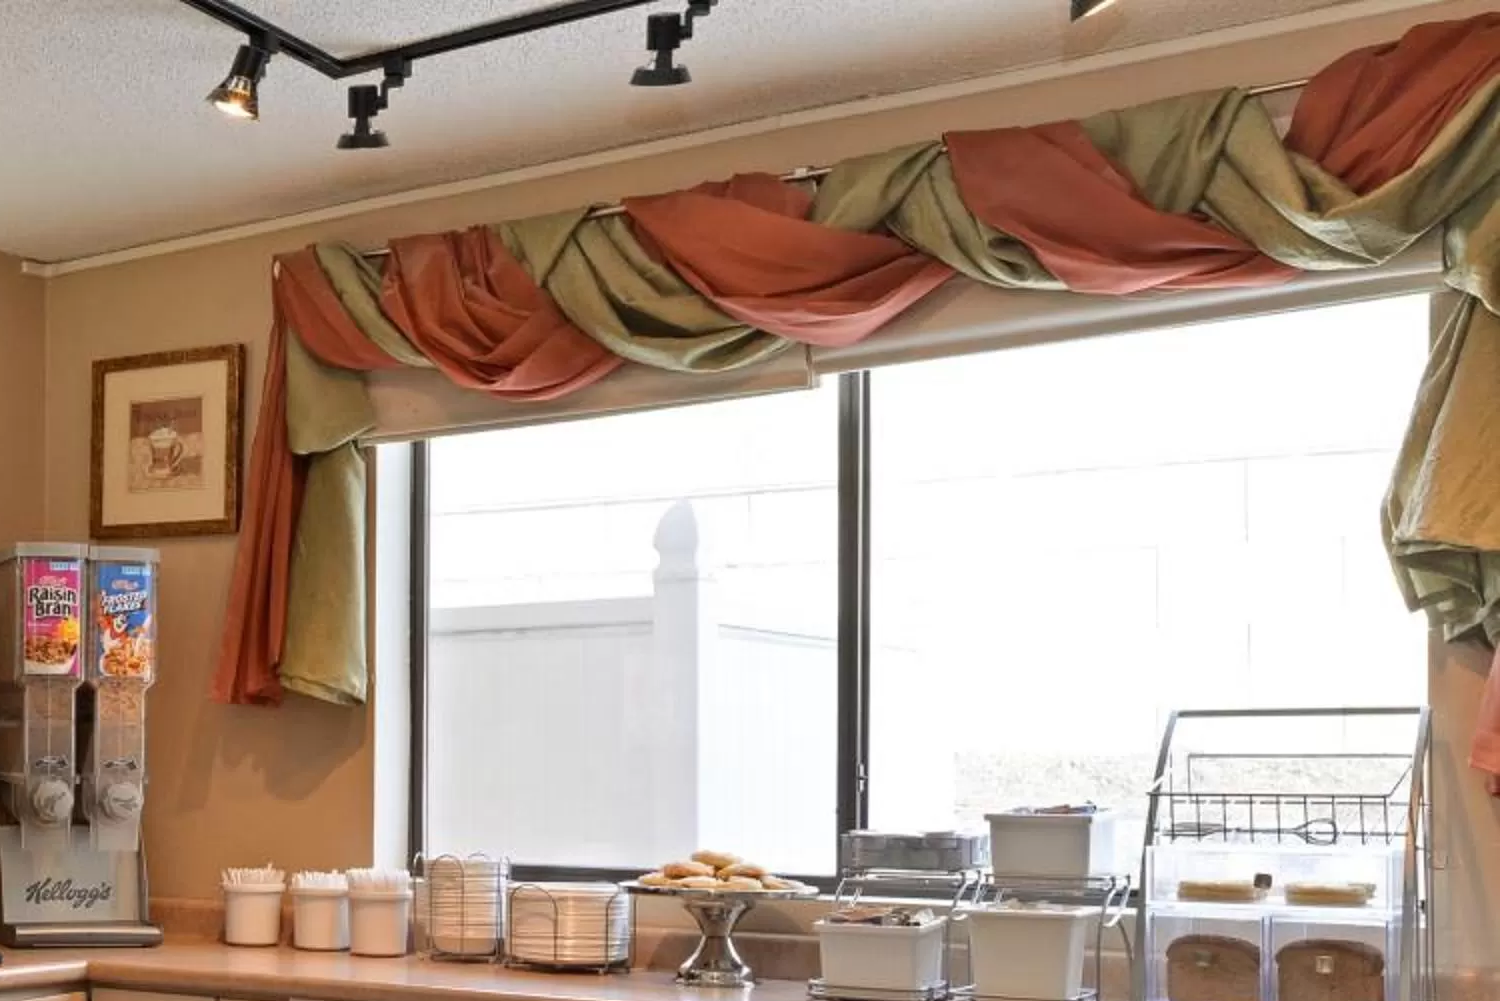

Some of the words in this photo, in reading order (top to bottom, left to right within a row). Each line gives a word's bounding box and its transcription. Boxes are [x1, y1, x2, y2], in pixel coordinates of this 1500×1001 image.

[28, 585, 78, 604] Raisin
[33, 600, 73, 618] Bran
[25, 877, 112, 909] Kellogg's
